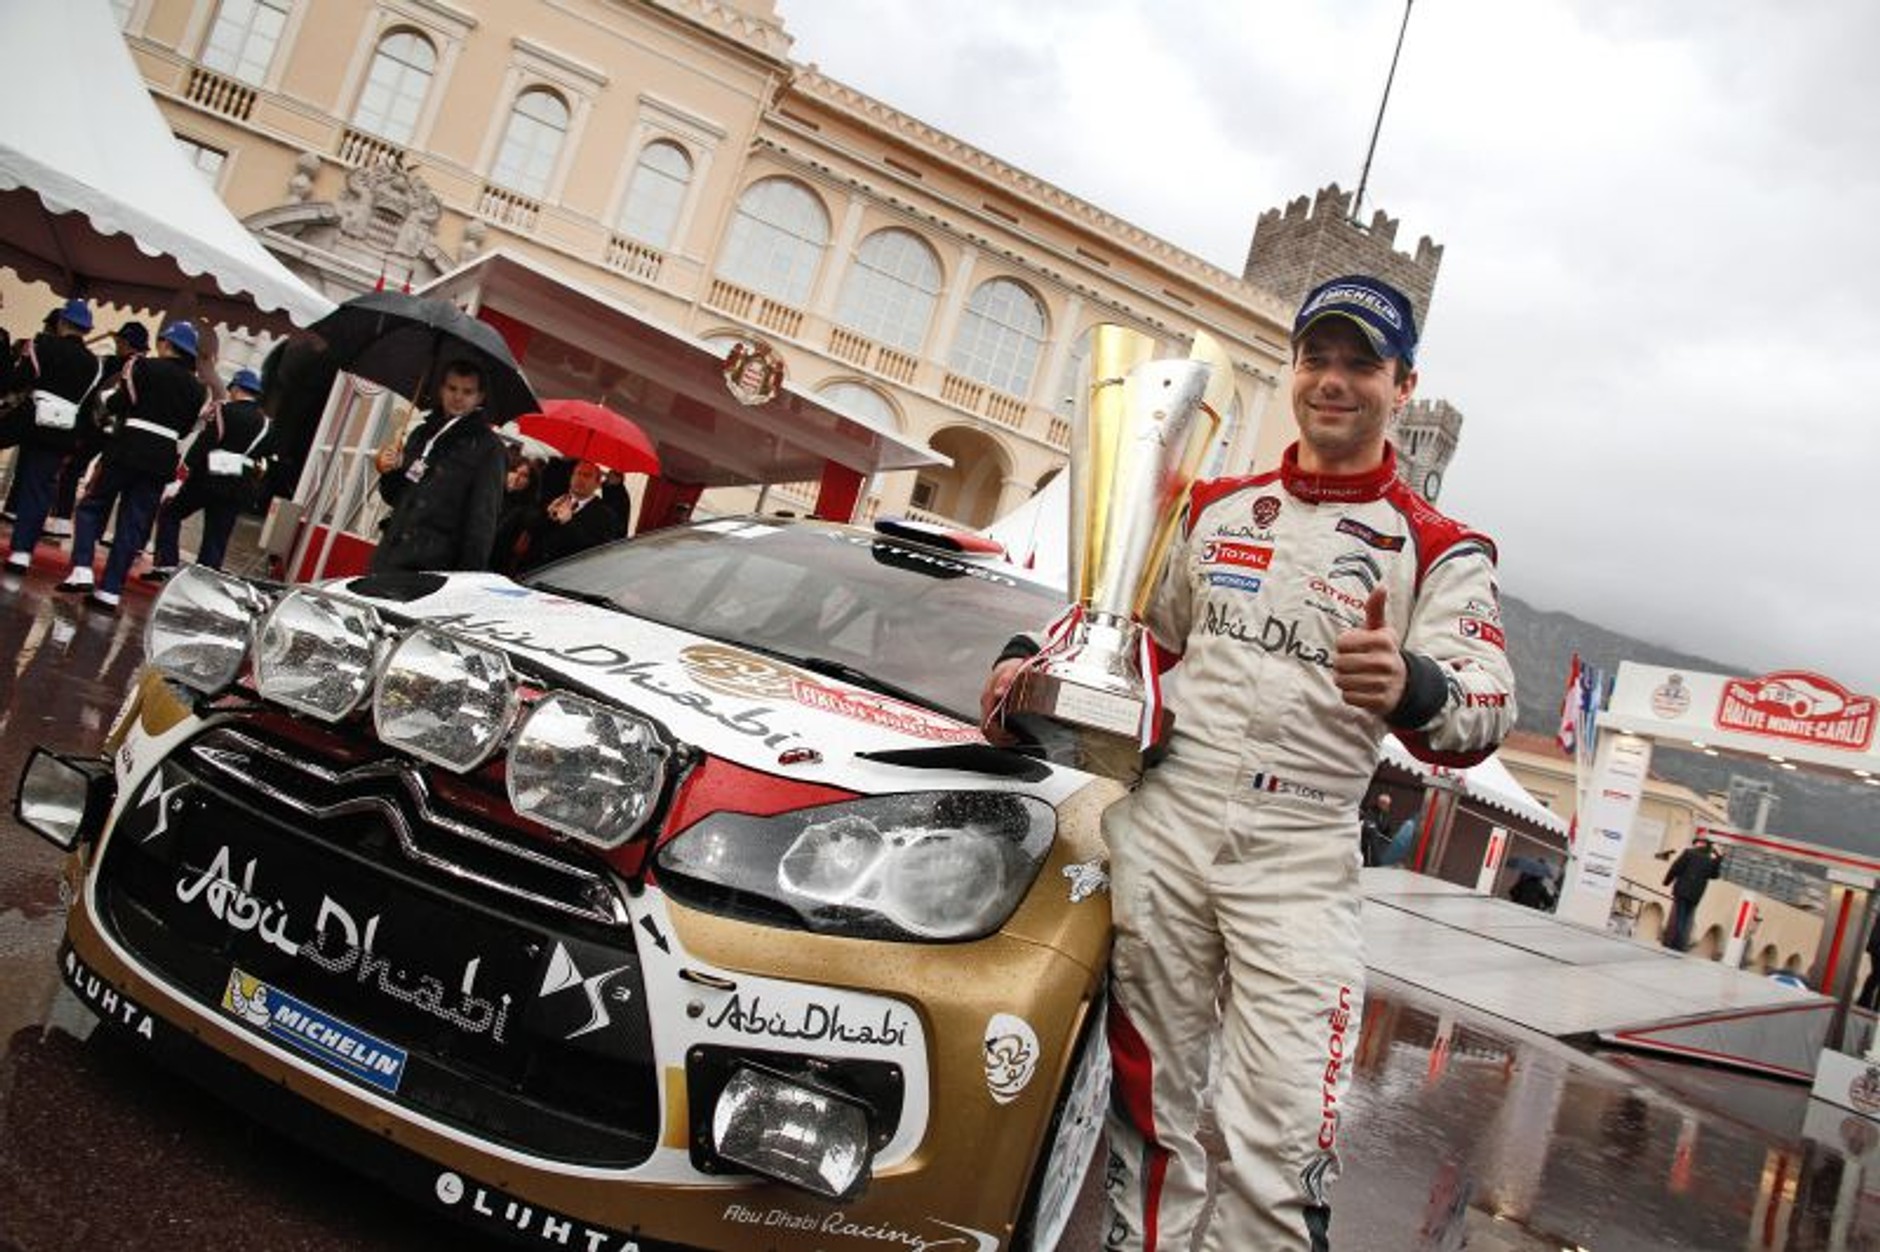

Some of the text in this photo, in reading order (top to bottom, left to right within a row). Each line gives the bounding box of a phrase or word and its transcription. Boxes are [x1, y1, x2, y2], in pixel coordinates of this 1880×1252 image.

[1221, 548, 1269, 564] TOTAL
[1259, 616, 1334, 669] Dha
[1722, 697, 1765, 731] RALLYE
[299, 895, 511, 1043] Dhabi
[74, 964, 154, 1040] LUHTA
[707, 993, 908, 1046] Abu Dhabi
[274, 1004, 399, 1076] MICHELIN
[722, 1204, 966, 1252] Abu Dhabi Racing
